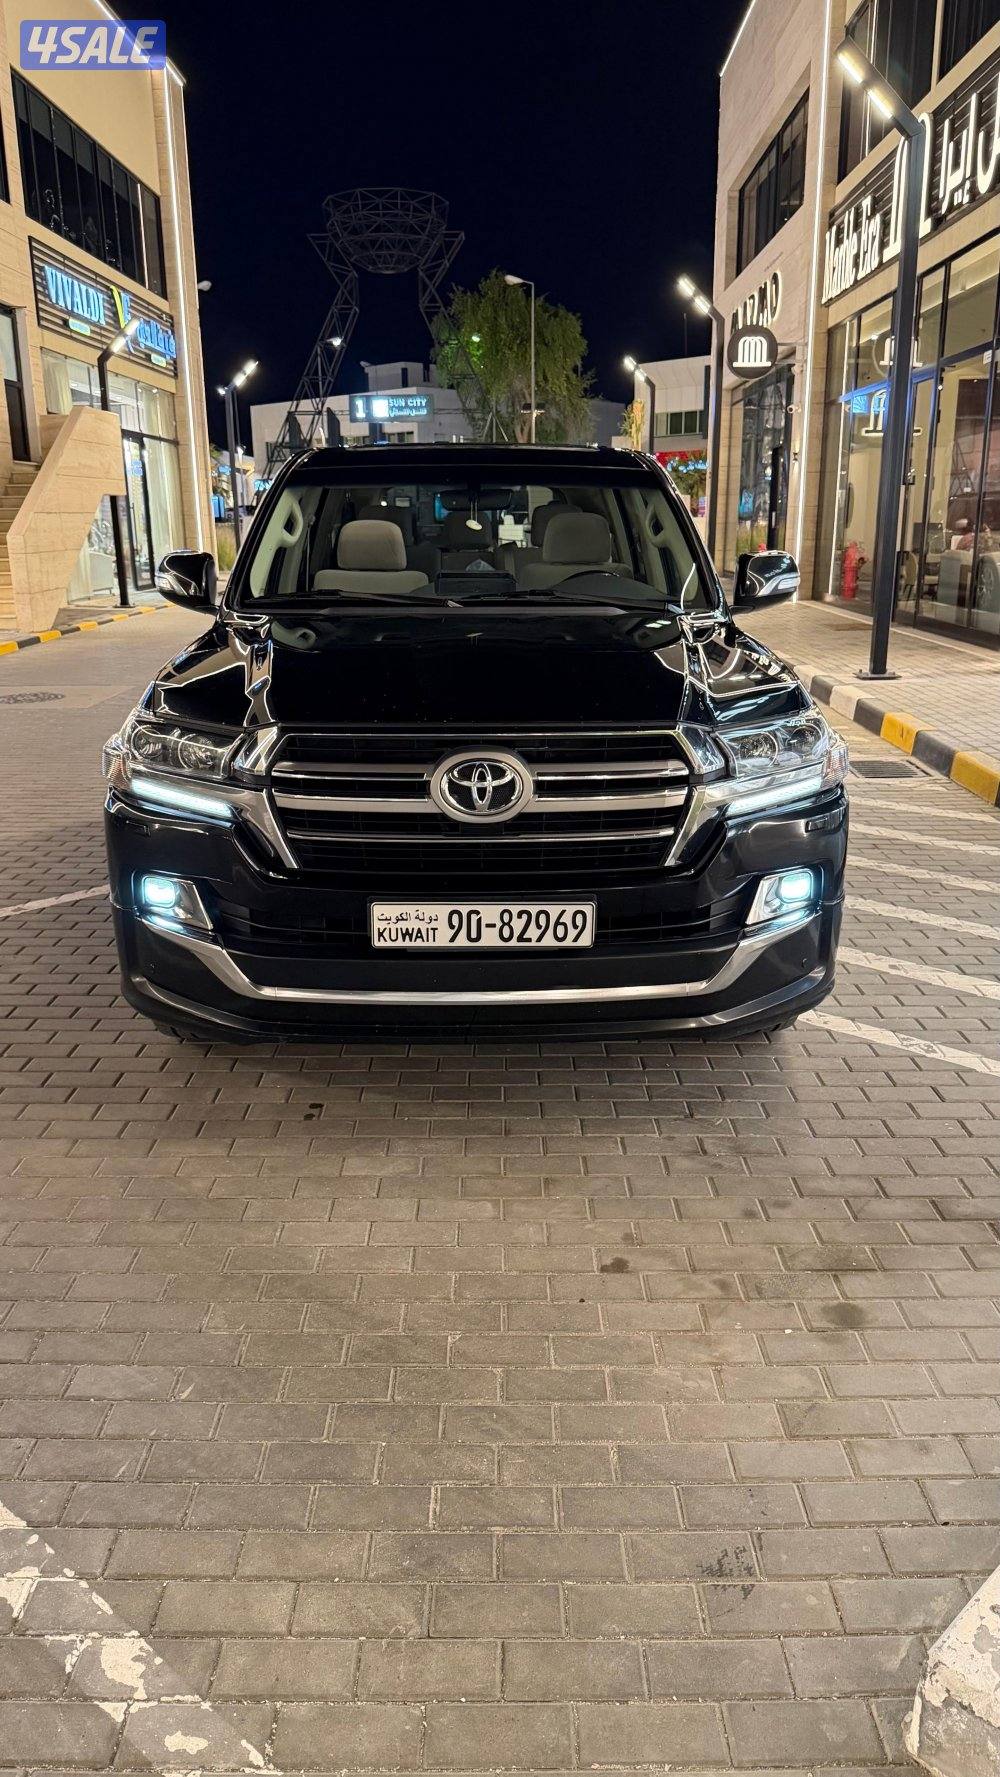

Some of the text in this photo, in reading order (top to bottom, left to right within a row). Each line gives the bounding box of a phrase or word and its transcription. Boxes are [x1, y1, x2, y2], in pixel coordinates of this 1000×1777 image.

[821, 210, 858, 304] Marble
[857, 195, 881, 280] Era
[44, 265, 106, 326] VIVALDI
[389, 398, 427, 407] SUN CITY
[377, 909, 439, 925] دولة الكويت
[447, 908, 588, 944] 90-82969
[377, 927, 439, 943] KUWAIT
